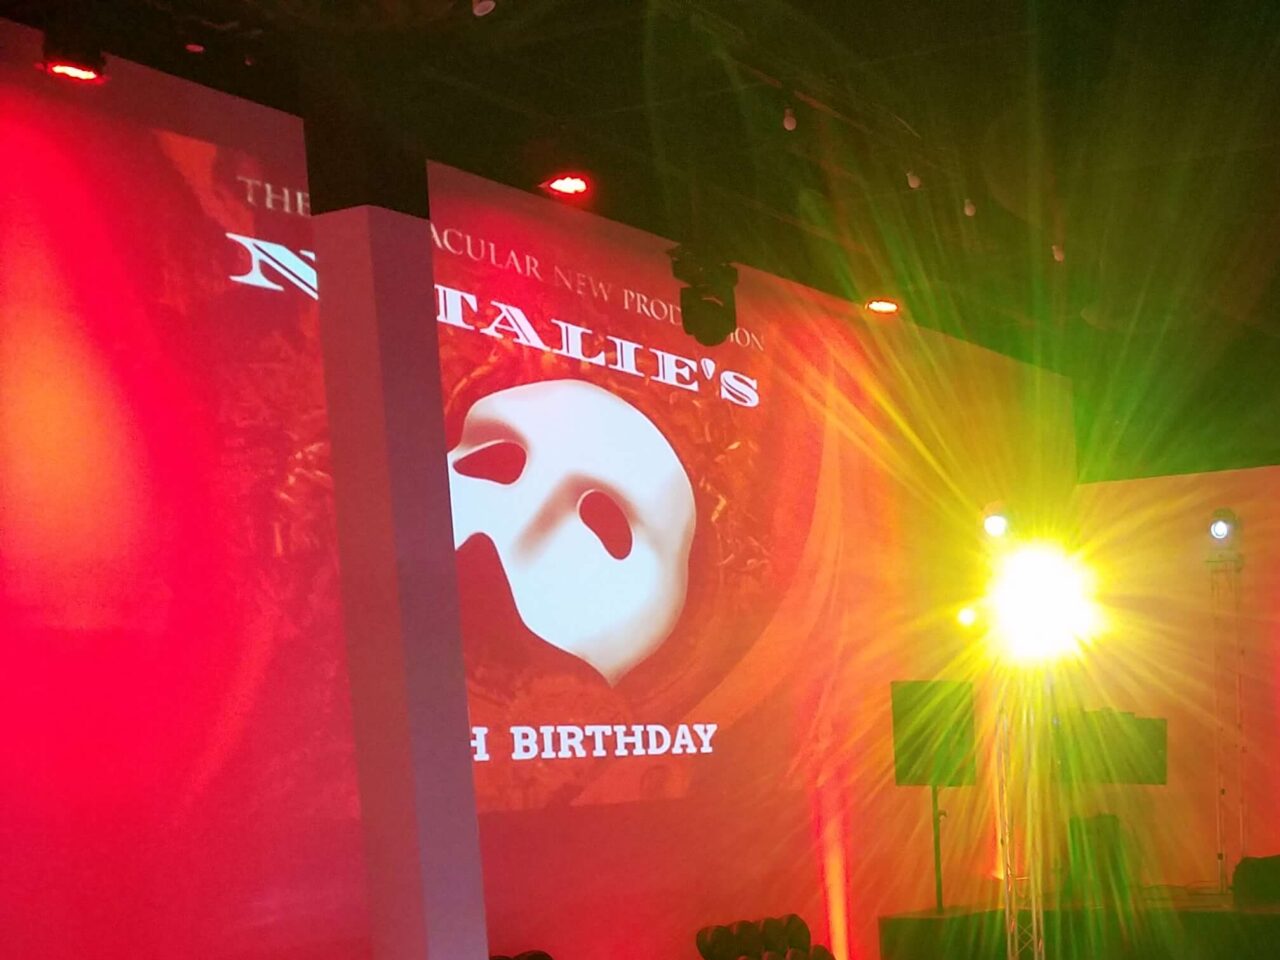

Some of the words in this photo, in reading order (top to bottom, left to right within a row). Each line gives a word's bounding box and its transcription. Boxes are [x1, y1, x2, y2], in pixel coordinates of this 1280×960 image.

[236, 175, 311, 218] THE
[553, 265, 612, 302] NEW
[510, 724, 718, 760] BIRTHDAY
